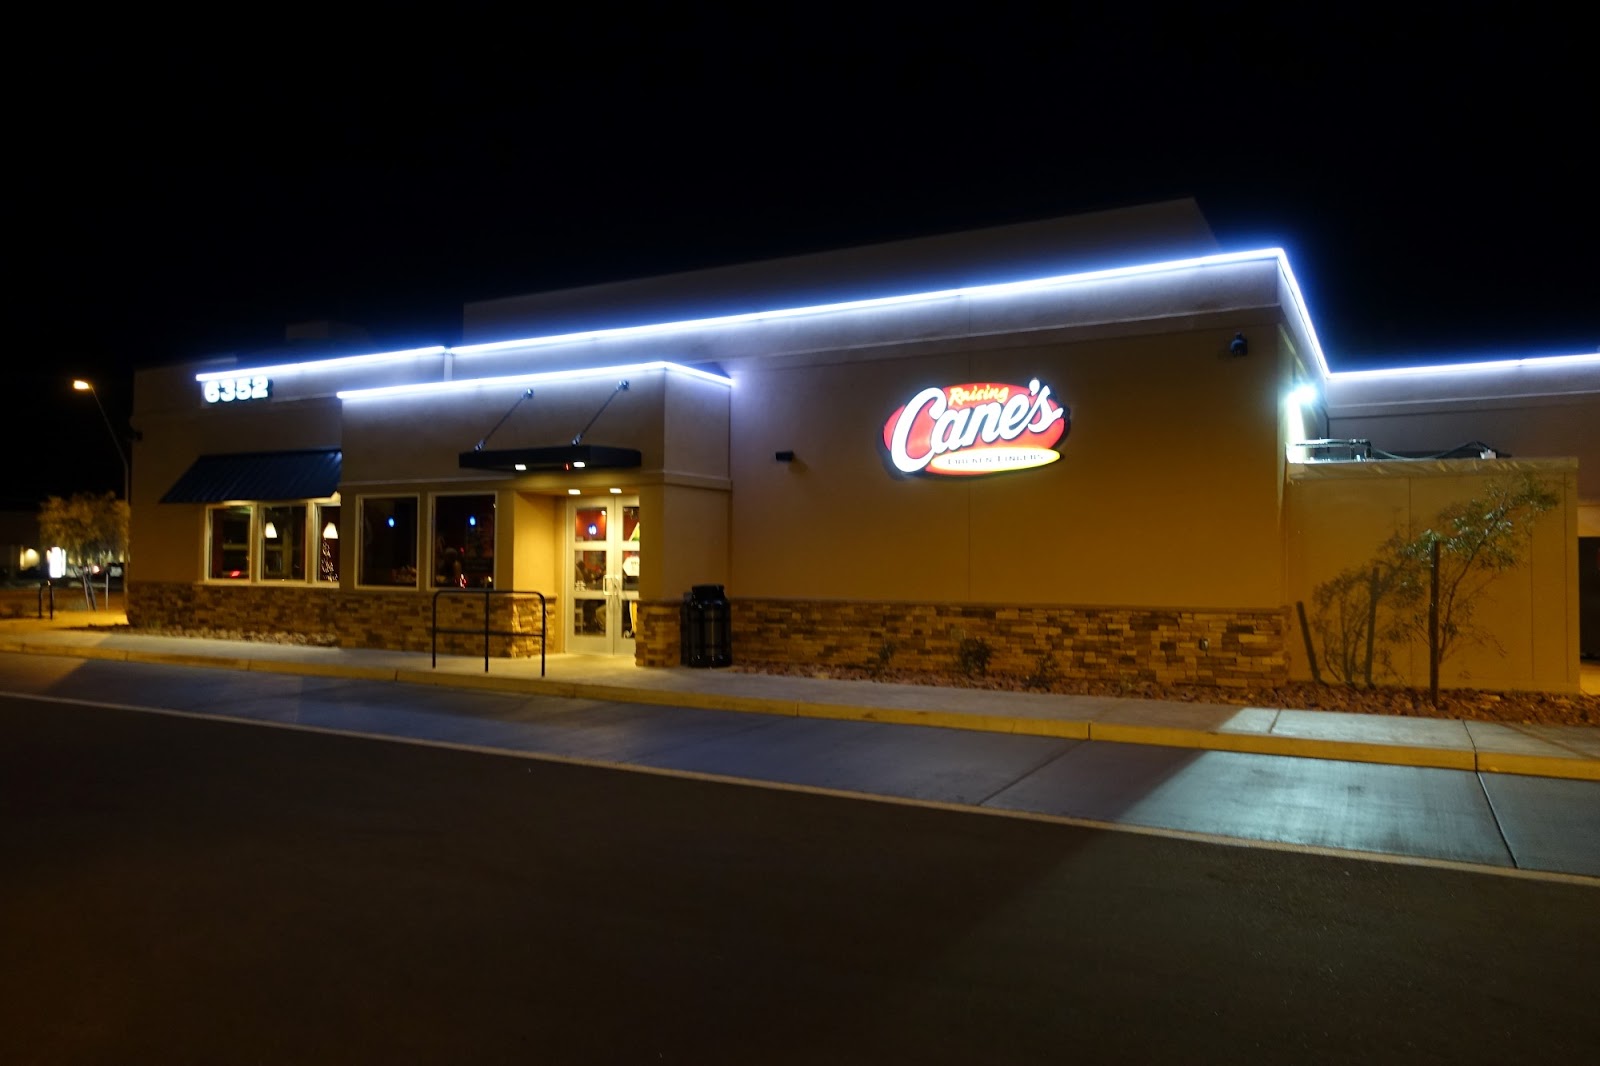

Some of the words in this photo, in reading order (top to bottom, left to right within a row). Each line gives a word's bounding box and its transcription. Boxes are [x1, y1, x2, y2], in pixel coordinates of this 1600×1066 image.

[204, 376, 269, 403] 6352
[948, 384, 1009, 406] Raising
[891, 377, 1064, 473] Cane's
